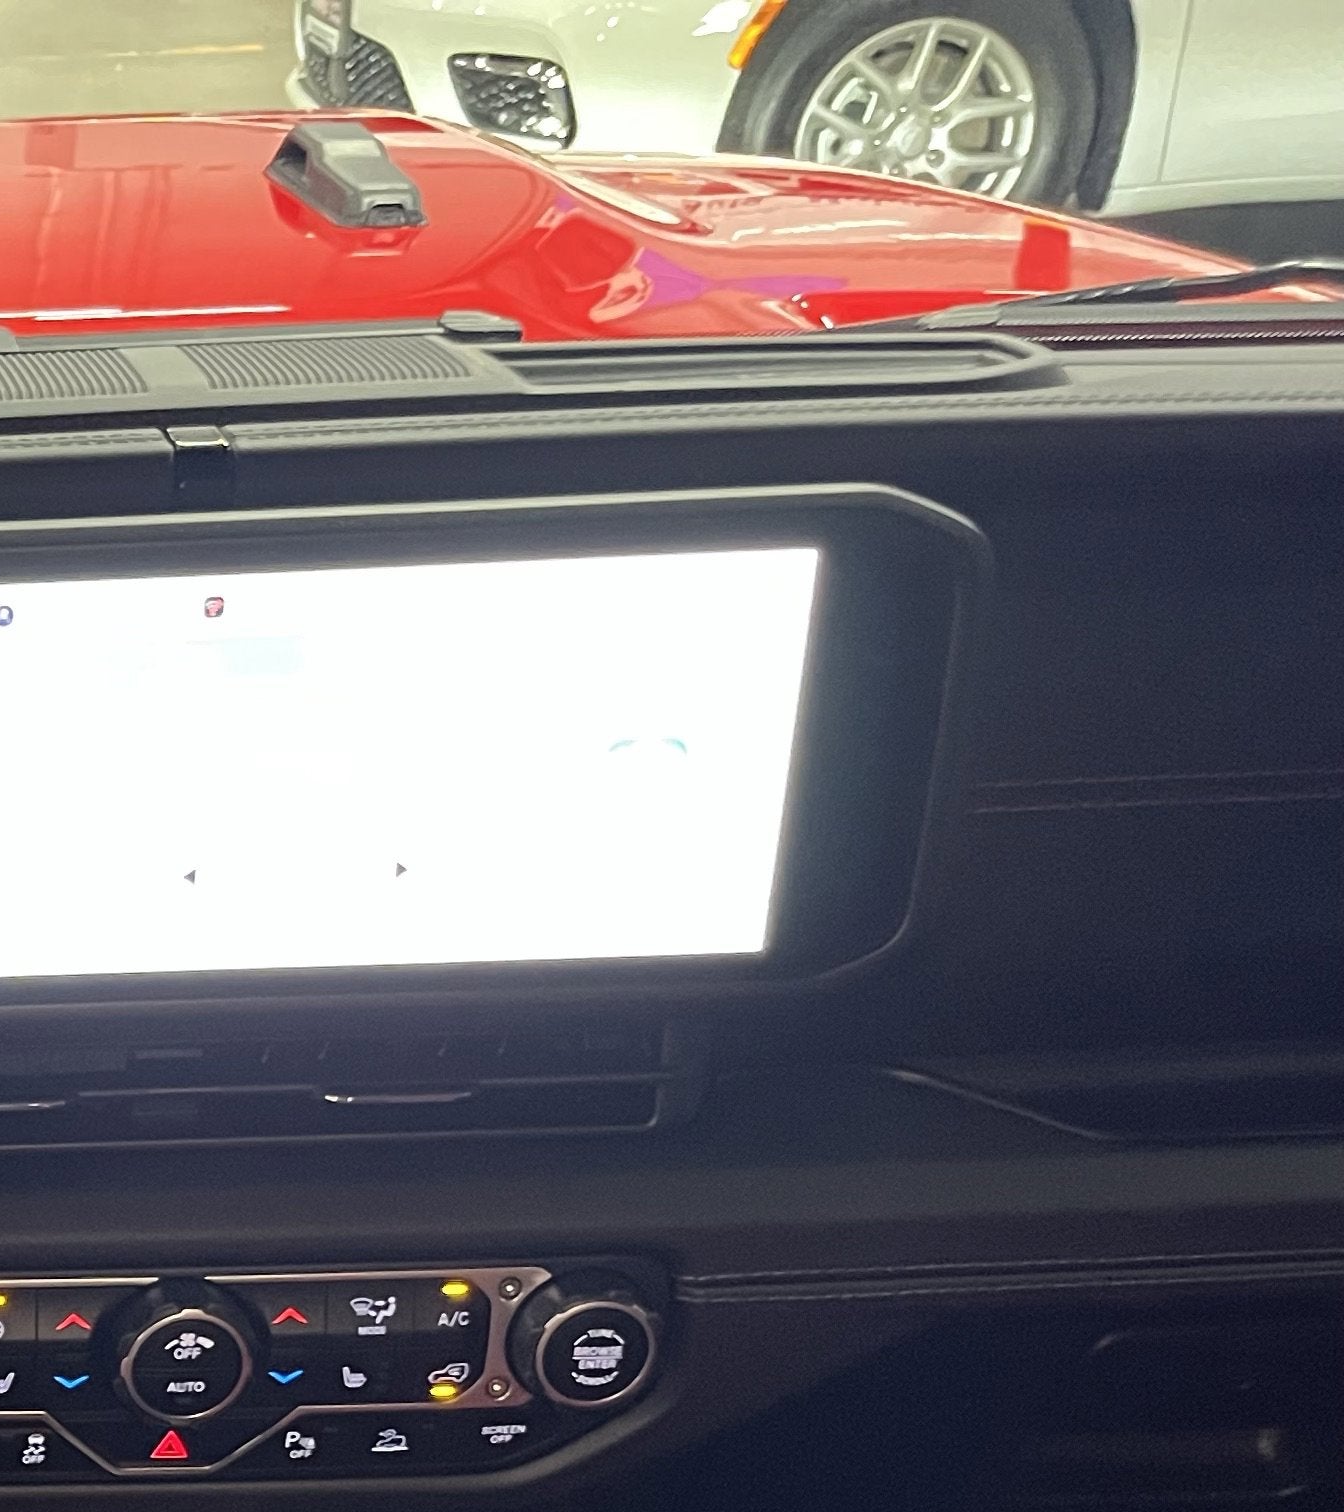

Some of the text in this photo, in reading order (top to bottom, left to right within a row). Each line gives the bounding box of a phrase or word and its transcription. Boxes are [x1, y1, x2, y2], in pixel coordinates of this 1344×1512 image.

[438, 1310, 471, 1327] A/C
[173, 1346, 202, 1360] OFF
[166, 1381, 206, 1393] AUTO
[480, 1424, 527, 1435] SCREEN
[489, 1434, 513, 1444] OFF
[21, 1453, 46, 1465] OFF
